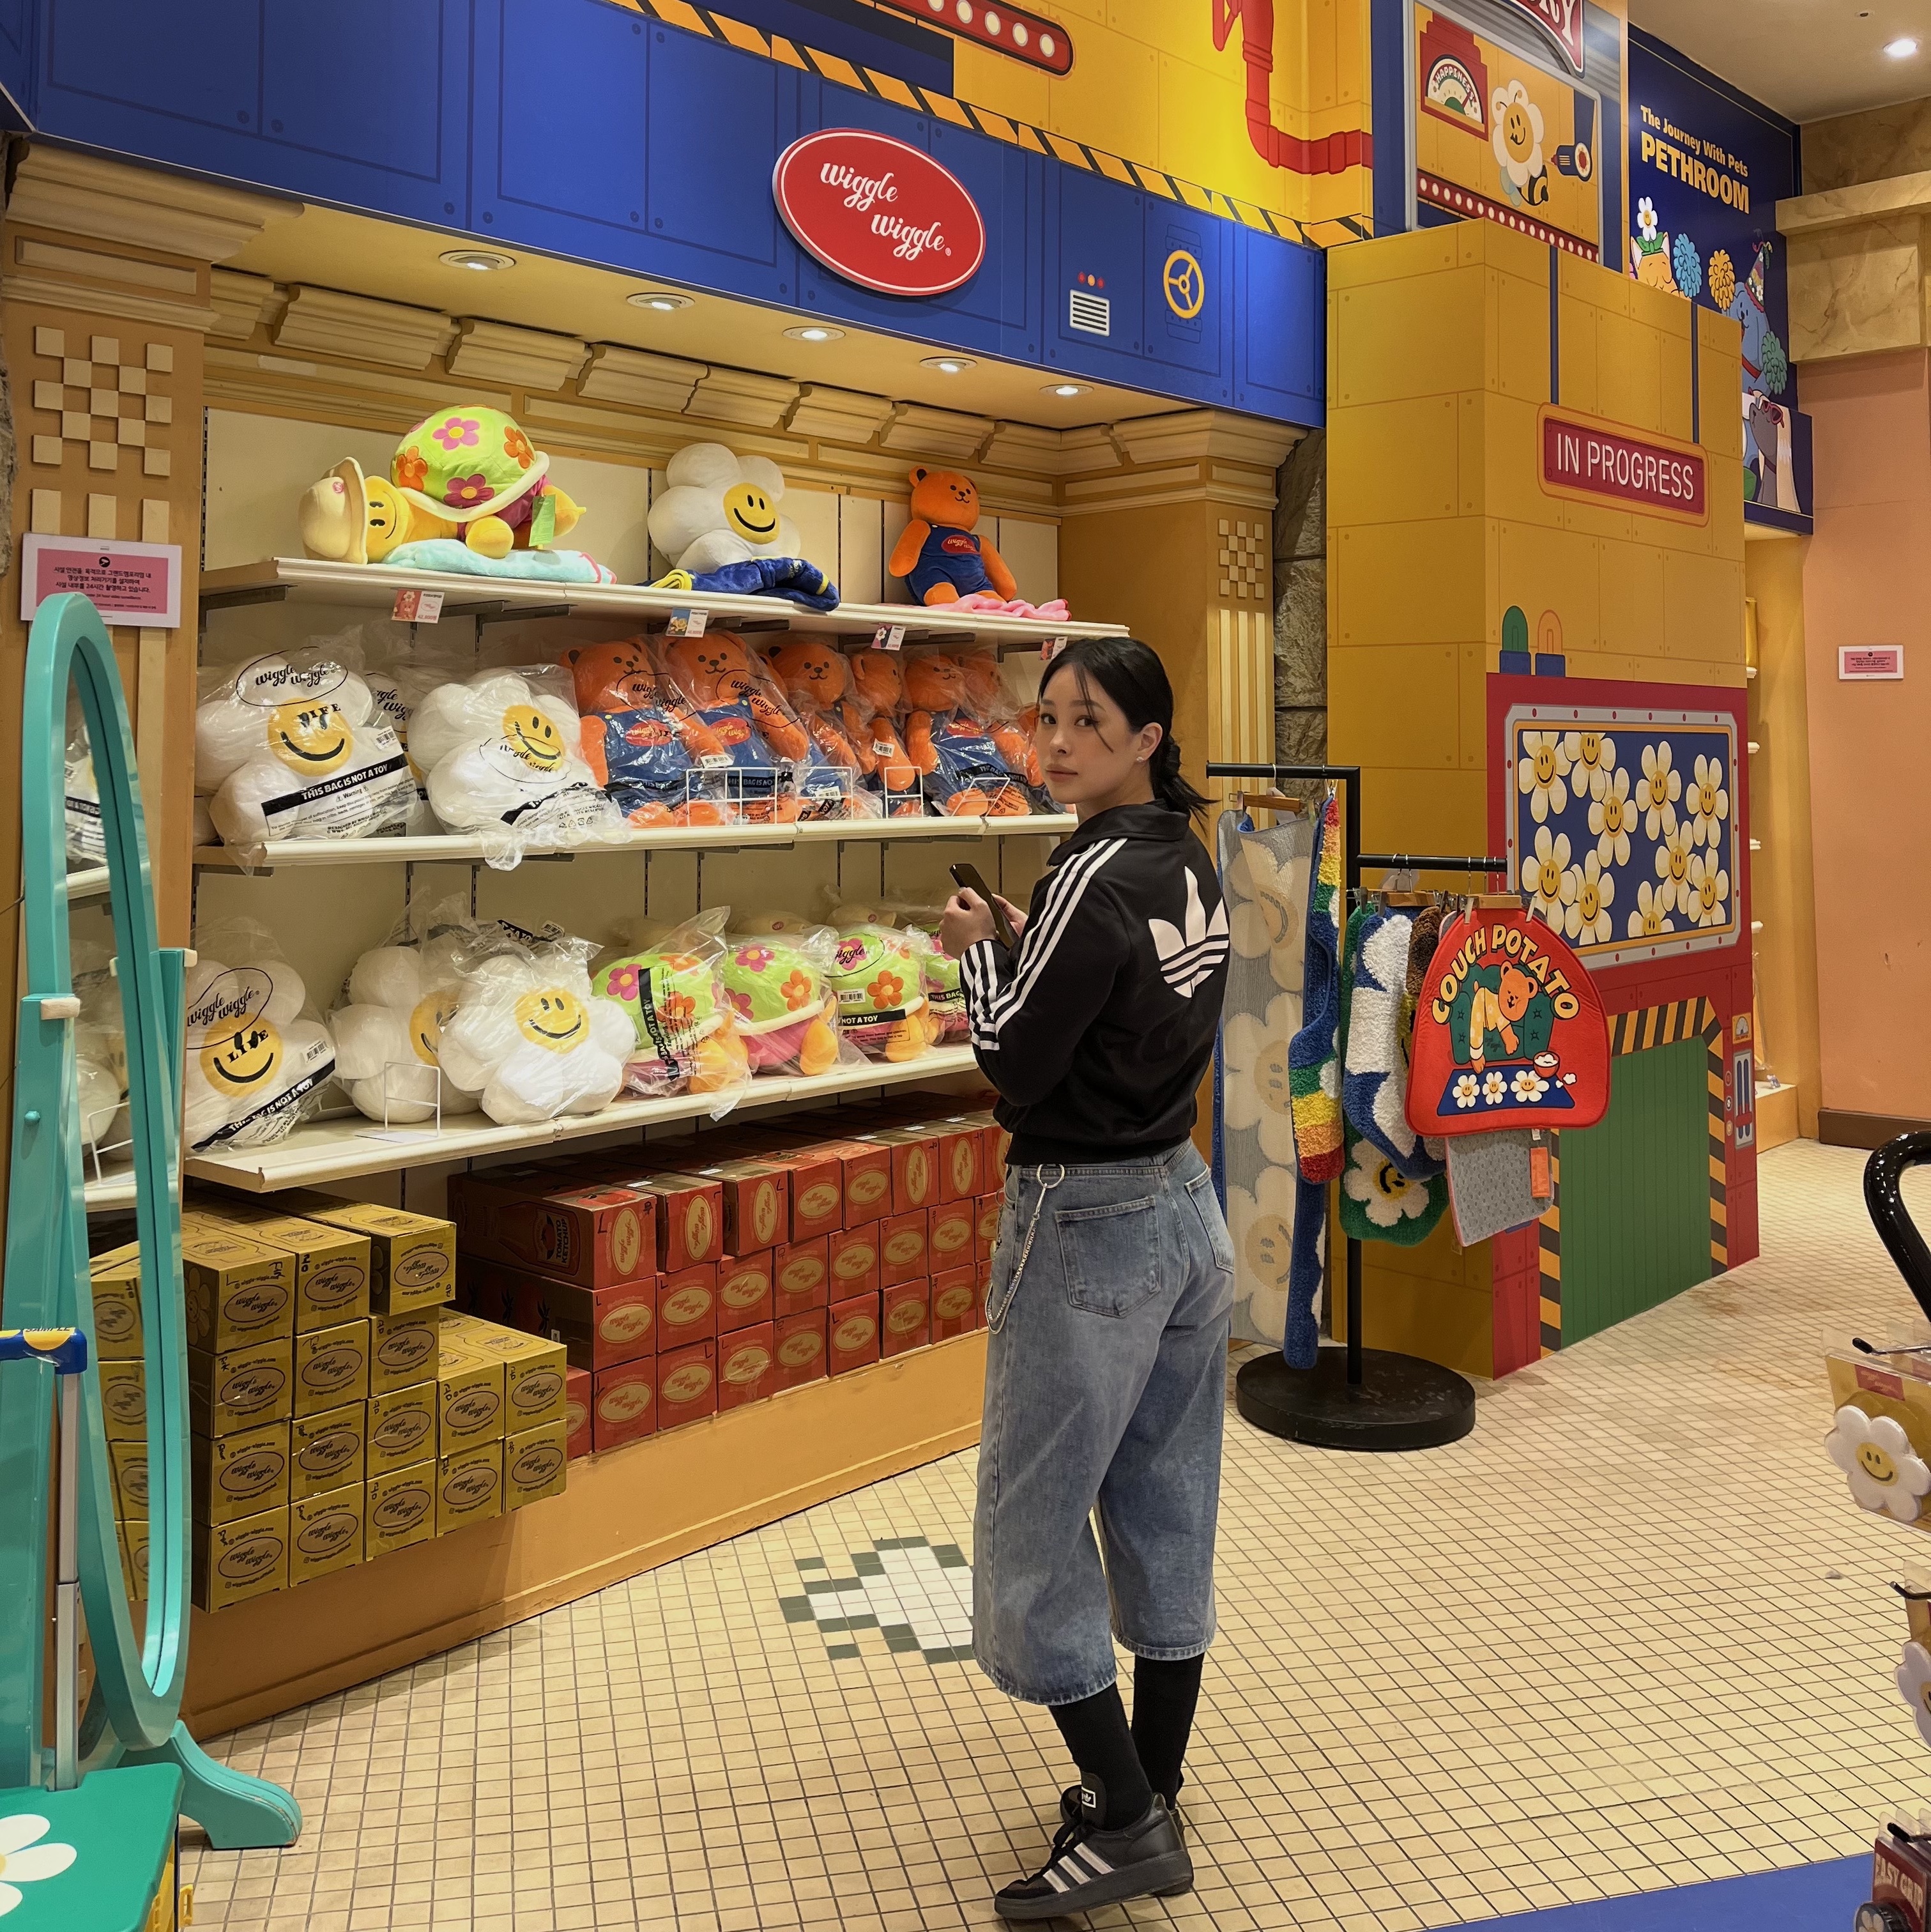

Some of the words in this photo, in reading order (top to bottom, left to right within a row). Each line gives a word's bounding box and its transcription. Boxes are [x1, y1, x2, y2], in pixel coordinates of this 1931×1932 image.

[1435, 66, 1474, 100] HAPPINESS
[1640, 104, 1661, 130] The
[1663, 118, 1701, 155] Journey
[1703, 139, 1726, 165] With
[1728, 153, 1748, 178] Pets
[1641, 130, 1750, 214] PETHROOM
[1557, 433, 1579, 474] IN
[1587, 440, 1694, 500] PROGRESS
[301, 786, 324, 800] THIS
[324, 781, 344, 795] BAG
[343, 777, 352, 788] IS
[351, 770, 367, 784] NOT
[368, 769, 374, 778] A
[374, 763, 388, 776] TOY
[218, 986, 255, 1019] wiggle
[1432, 926, 1486, 1024] COUCH
[1491, 923, 1580, 1020] POTATO
[266, 1104, 276, 1114] IS
[275, 1092, 293, 1109] NOT
[291, 1088, 300, 1098] A
